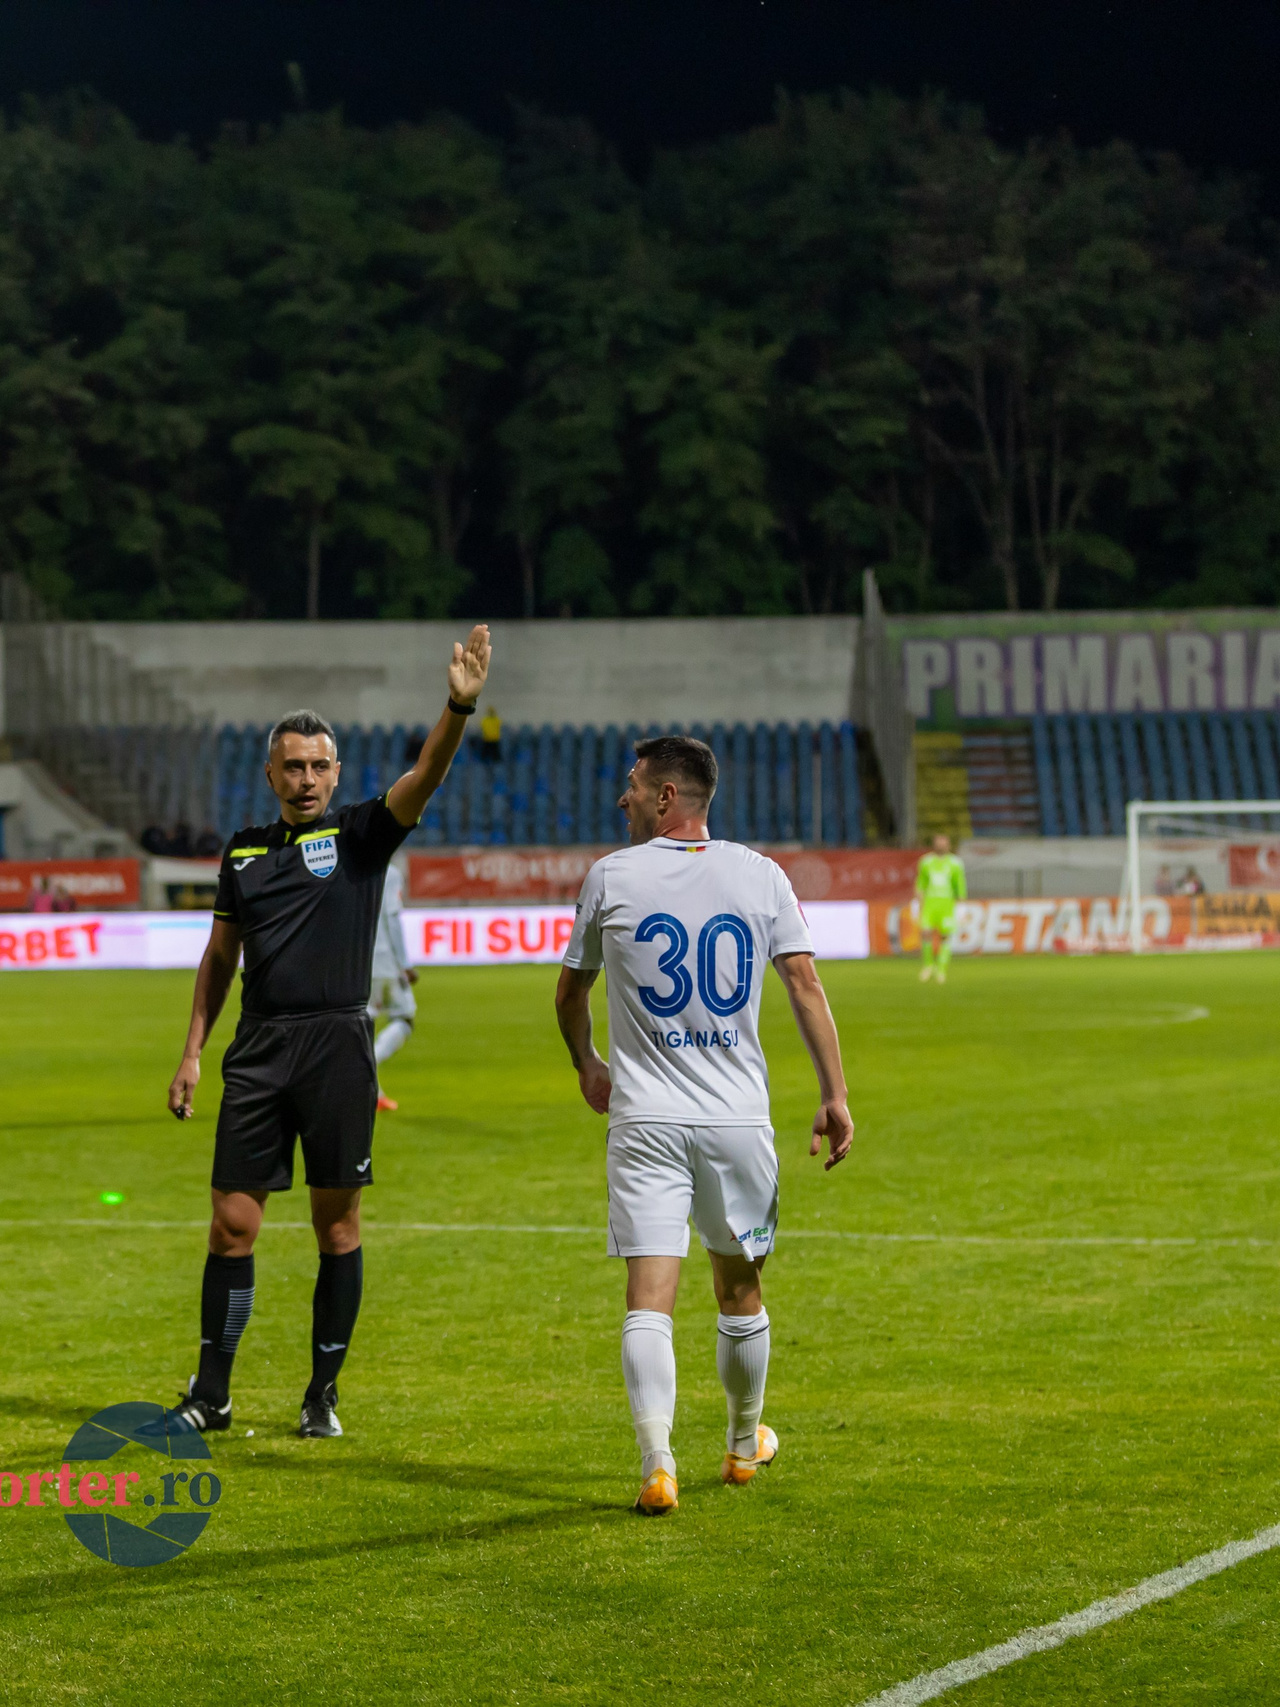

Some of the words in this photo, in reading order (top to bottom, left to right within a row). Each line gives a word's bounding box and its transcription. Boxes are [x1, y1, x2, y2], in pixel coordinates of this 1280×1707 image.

[305, 839, 333, 853] FIFA
[307, 854, 335, 864] REFEREE
[424, 920, 472, 955] FII
[487, 919, 575, 954] SUP
[634, 912, 754, 1018] 30
[752, 1227, 769, 1237] Eco
